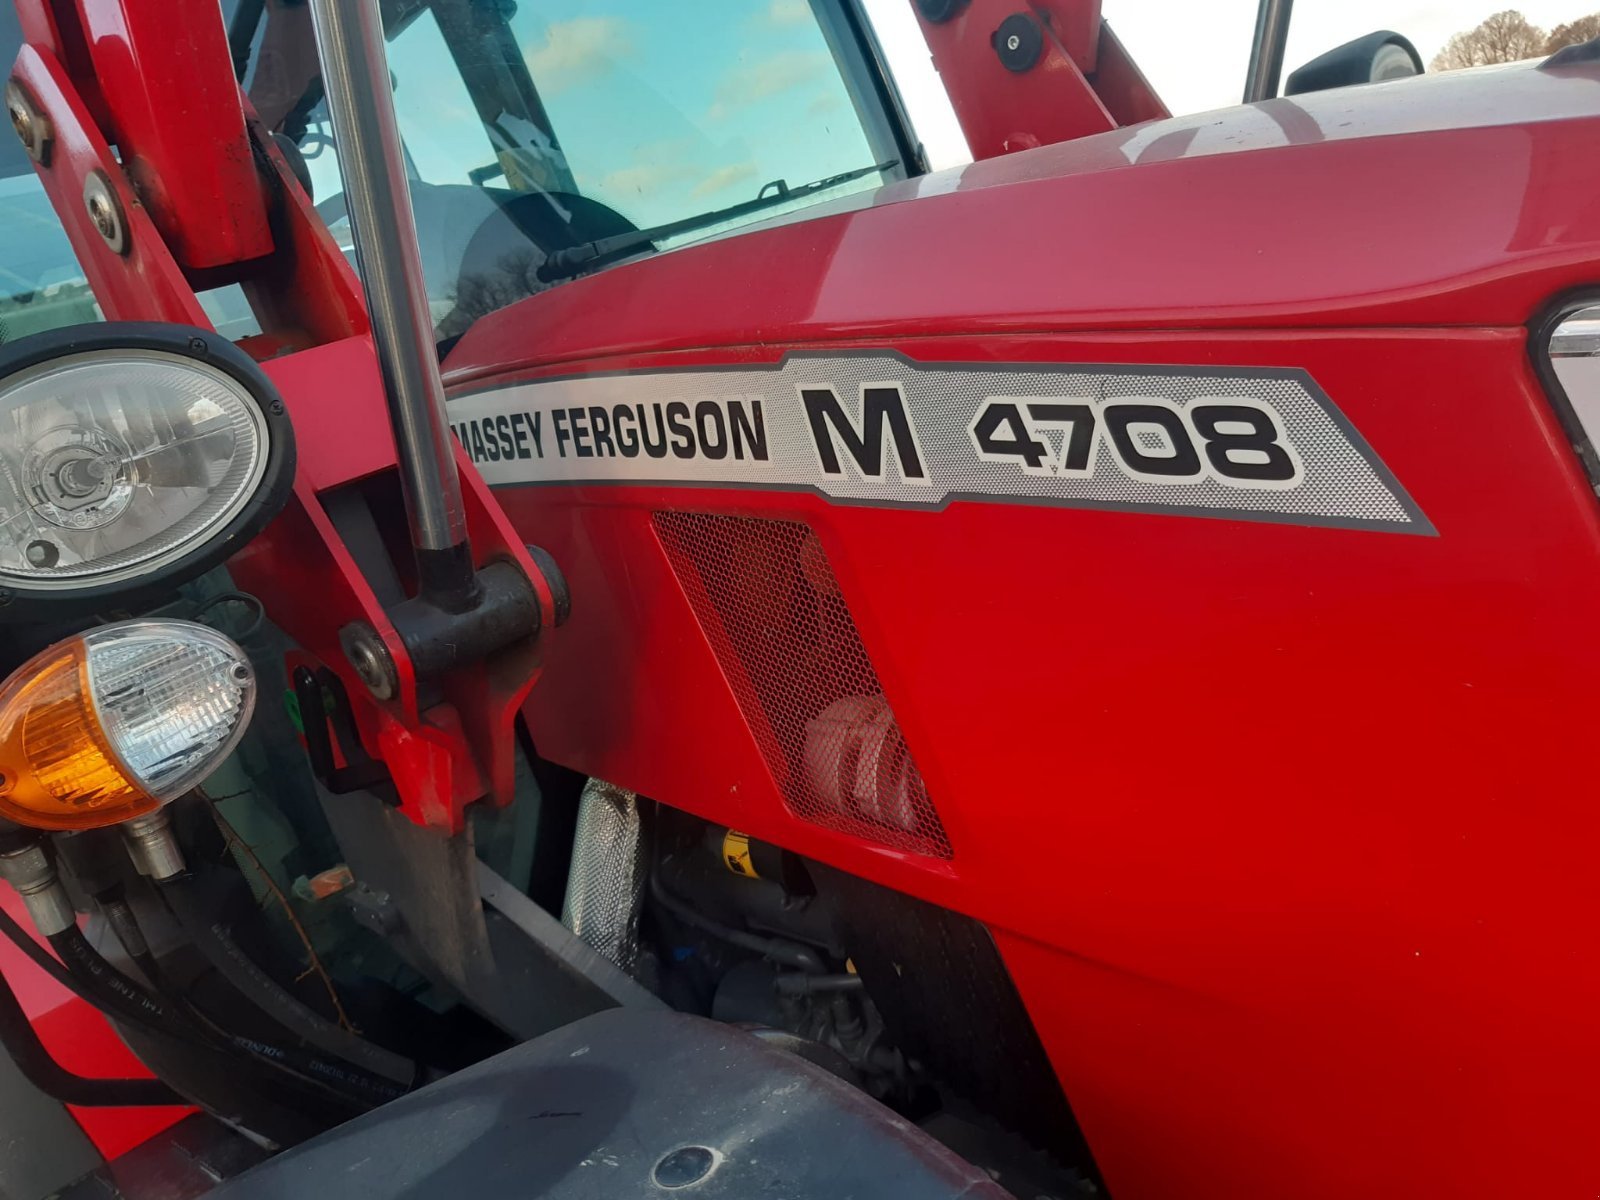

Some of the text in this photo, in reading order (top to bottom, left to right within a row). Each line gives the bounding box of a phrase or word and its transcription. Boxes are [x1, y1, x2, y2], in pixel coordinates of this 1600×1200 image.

[451, 388, 1297, 481] MASSEY FERGUSON M 4708
